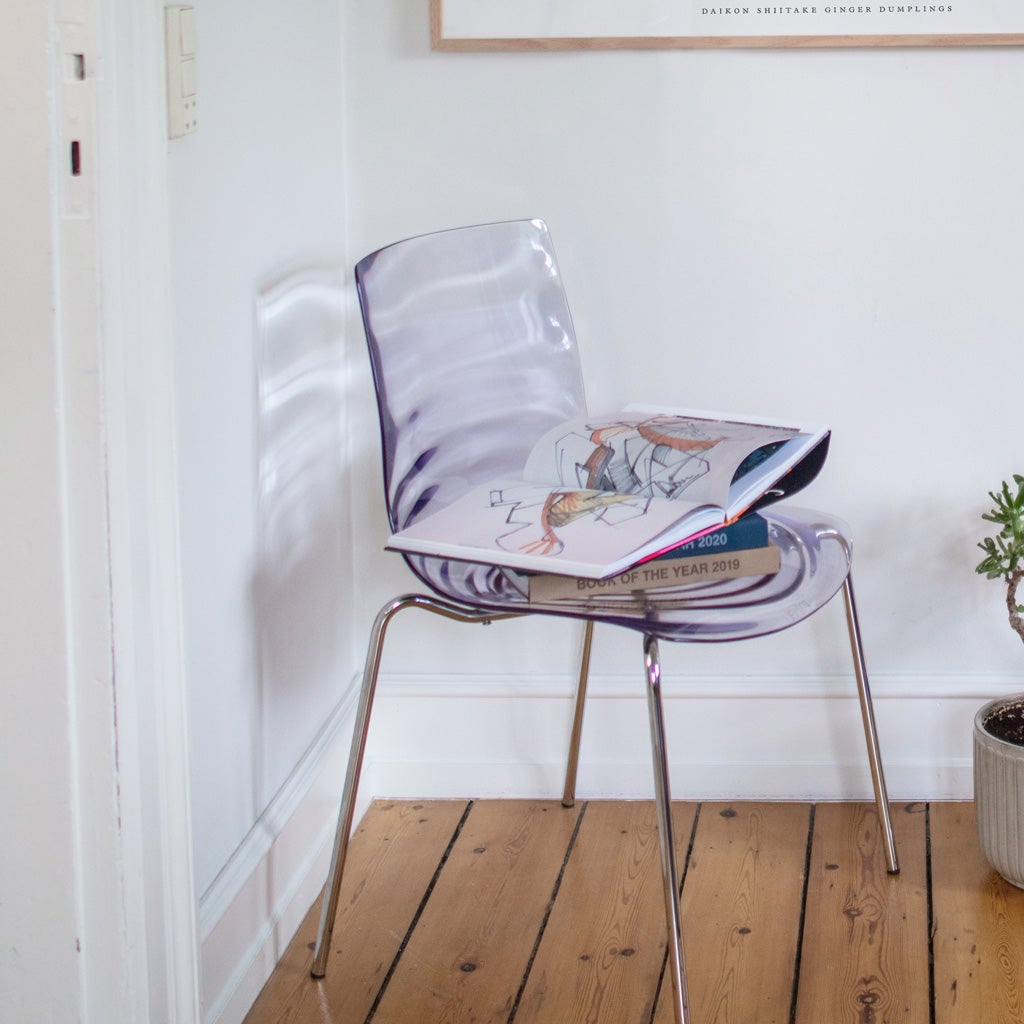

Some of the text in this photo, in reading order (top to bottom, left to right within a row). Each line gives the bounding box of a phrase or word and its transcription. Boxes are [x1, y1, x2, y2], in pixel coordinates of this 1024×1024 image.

[701, 5, 953, 15] DAIKON SHIITAKE GINGER DUMPLINGS
[697, 533, 728, 548] 2020
[620, 571, 639, 584] OF
[642, 569, 669, 582] THE
[672, 564, 709, 578] YEAR
[711, 558, 741, 572] 2019
